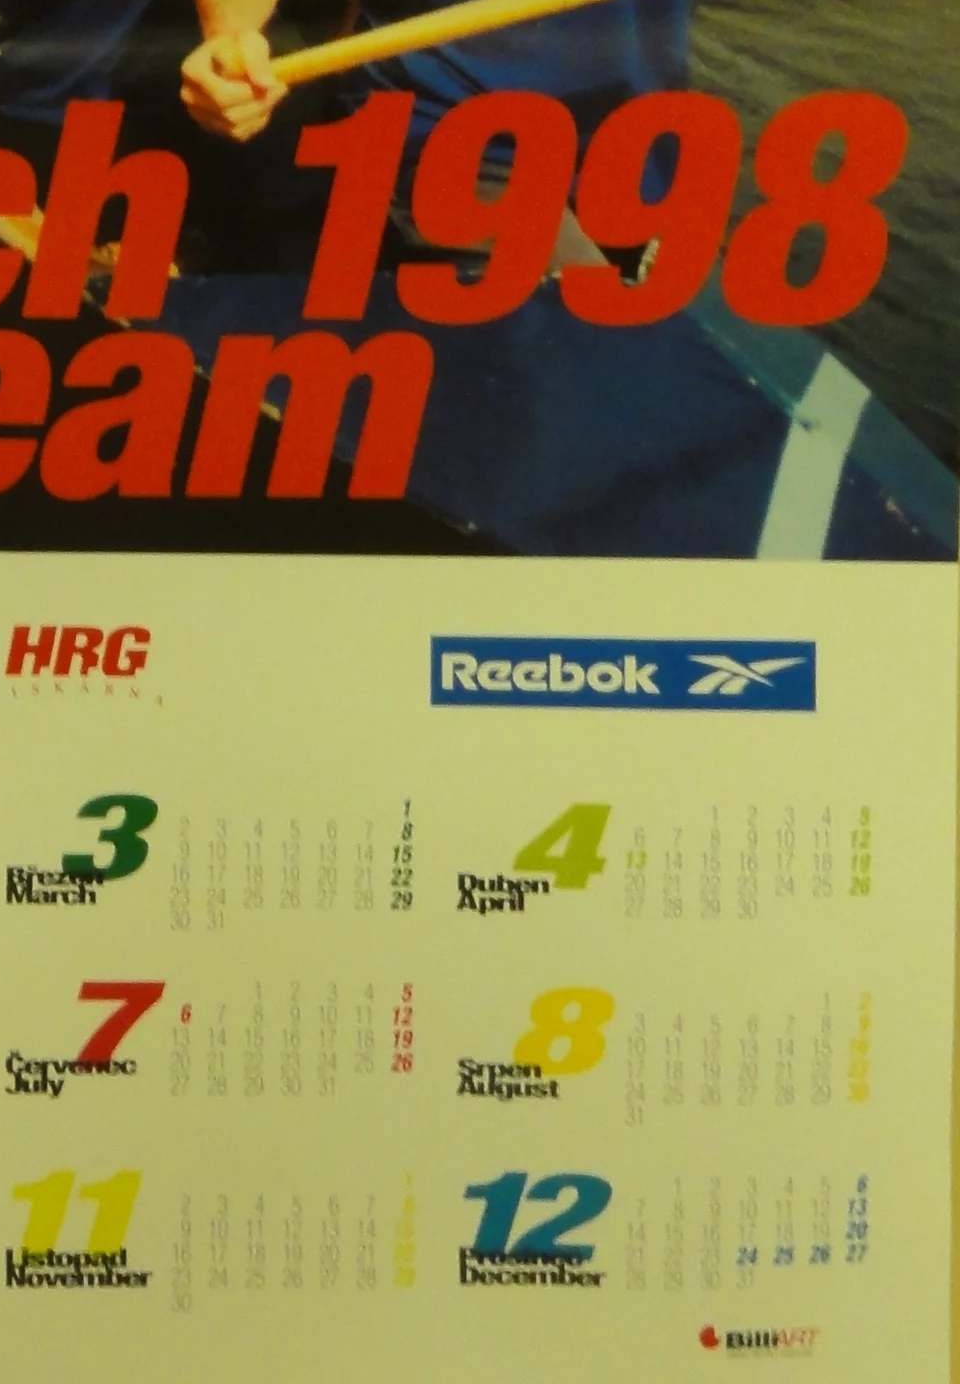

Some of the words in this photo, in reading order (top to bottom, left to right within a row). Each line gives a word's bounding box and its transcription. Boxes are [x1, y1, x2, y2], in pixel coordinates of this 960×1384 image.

[296, 90, 905, 327] 1998
[5, 626, 151, 677] HRG
[441, 651, 661, 695] Reebok
[61, 793, 159, 881] 3
[401, 819, 414, 841] 8
[393, 843, 413, 865] 15
[513, 802, 612, 890] 4
[390, 867, 414, 889] 22
[457, 872, 550, 894] Duben
[6, 884, 96, 906] March
[390, 890, 414, 912] 29
[457, 891, 526, 915] April
[401, 981, 413, 1003] 5
[76, 980, 166, 1068] 7
[180, 1002, 192, 1024] 6
[393, 1005, 414, 1027] 12
[393, 1029, 414, 1051] 19
[512, 986, 615, 1076] 8
[391, 1052, 414, 1074] 26
[5, 1073, 65, 1097] July
[457, 1077, 560, 1101] August
[856, 1173, 869, 1195] 6
[11, 1170, 143, 1263] 11
[463, 1172, 613, 1263] 12
[847, 1197, 869, 1219] 13
[845, 1221, 869, 1243] 20
[6, 1247, 127, 1273] Listopad
[736, 1245, 759, 1267] 24
[773, 1245, 795, 1267] 25
[809, 1245, 831, 1267] 26
[845, 1244, 869, 1266] 27
[6, 1268, 152, 1289] November
